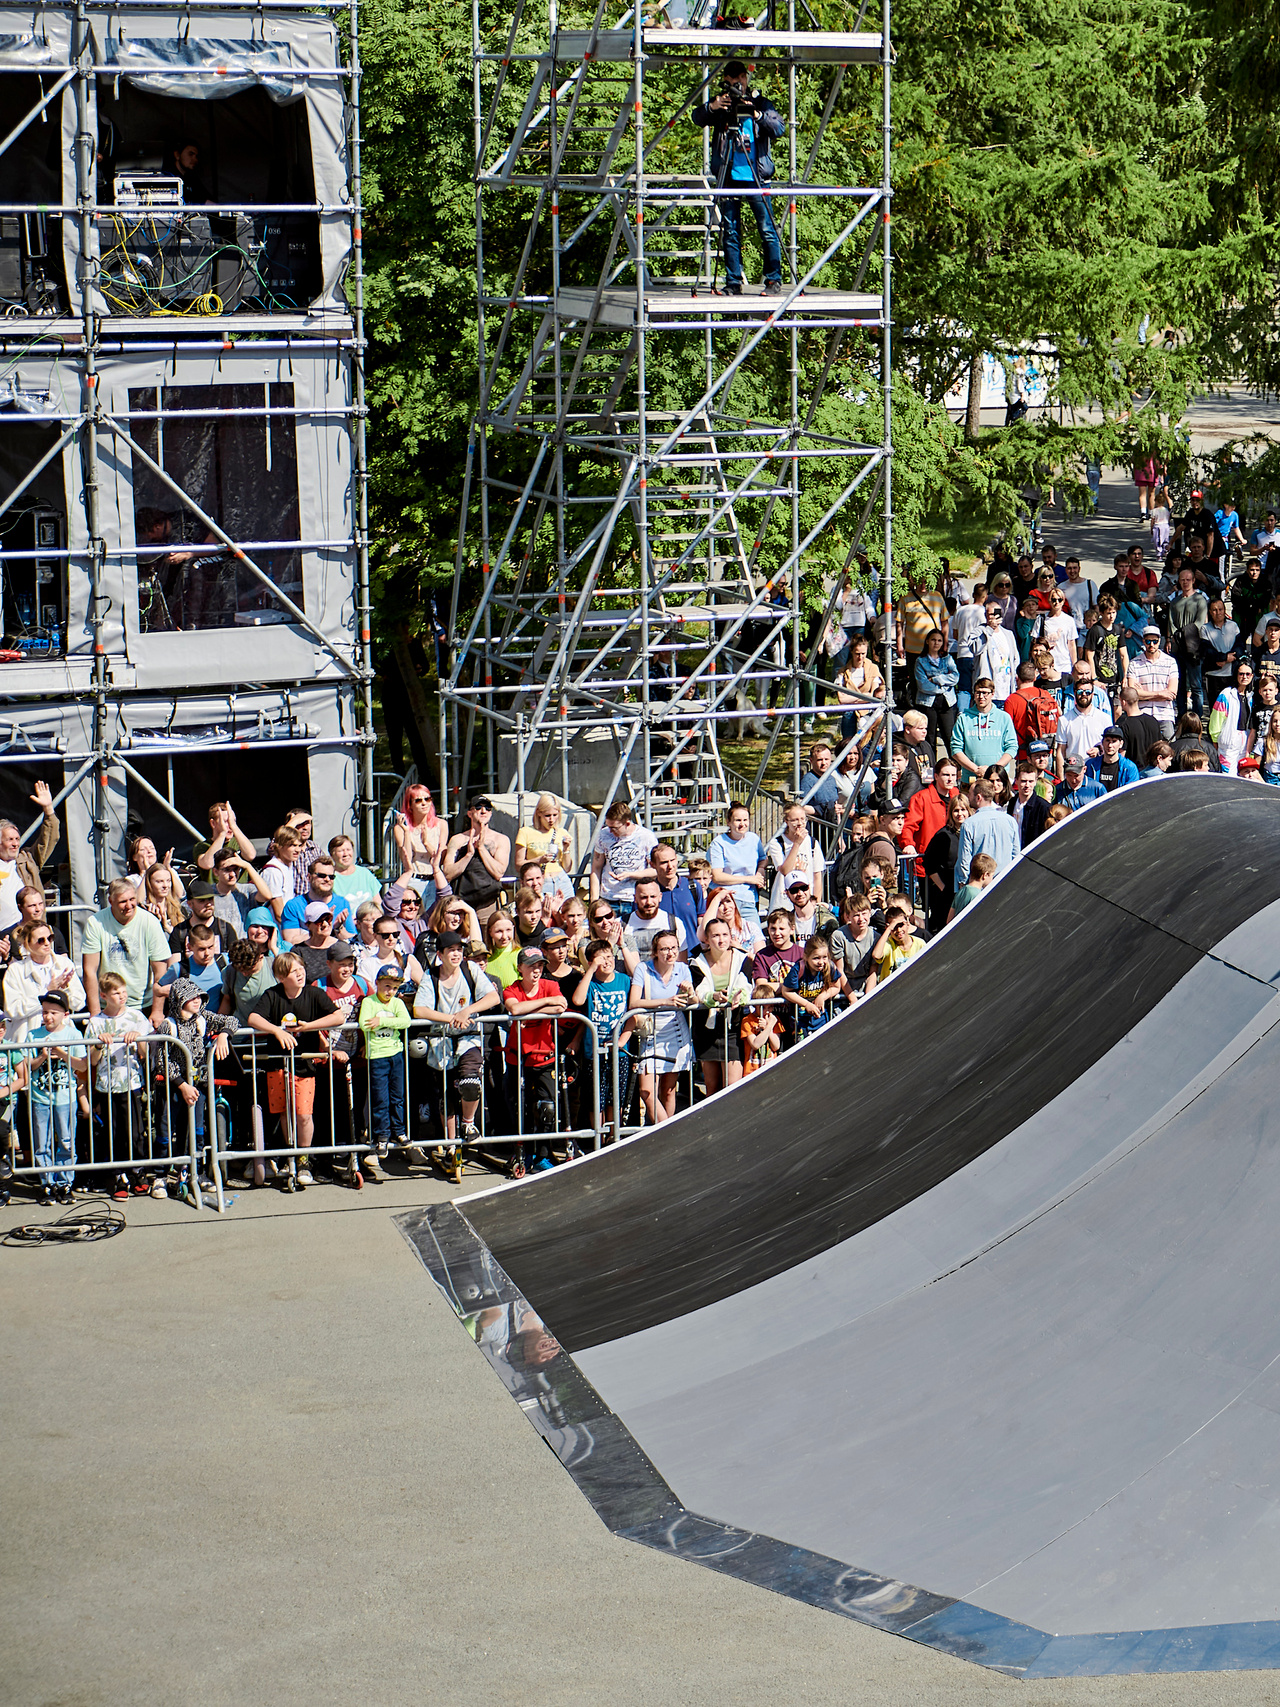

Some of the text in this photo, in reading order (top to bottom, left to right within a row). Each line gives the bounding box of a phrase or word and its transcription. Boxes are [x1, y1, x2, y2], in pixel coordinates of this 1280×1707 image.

[268, 227, 281, 235] 036
[966, 729, 1002, 737] HOLLISTER
[610, 844, 641, 859] Pacific
